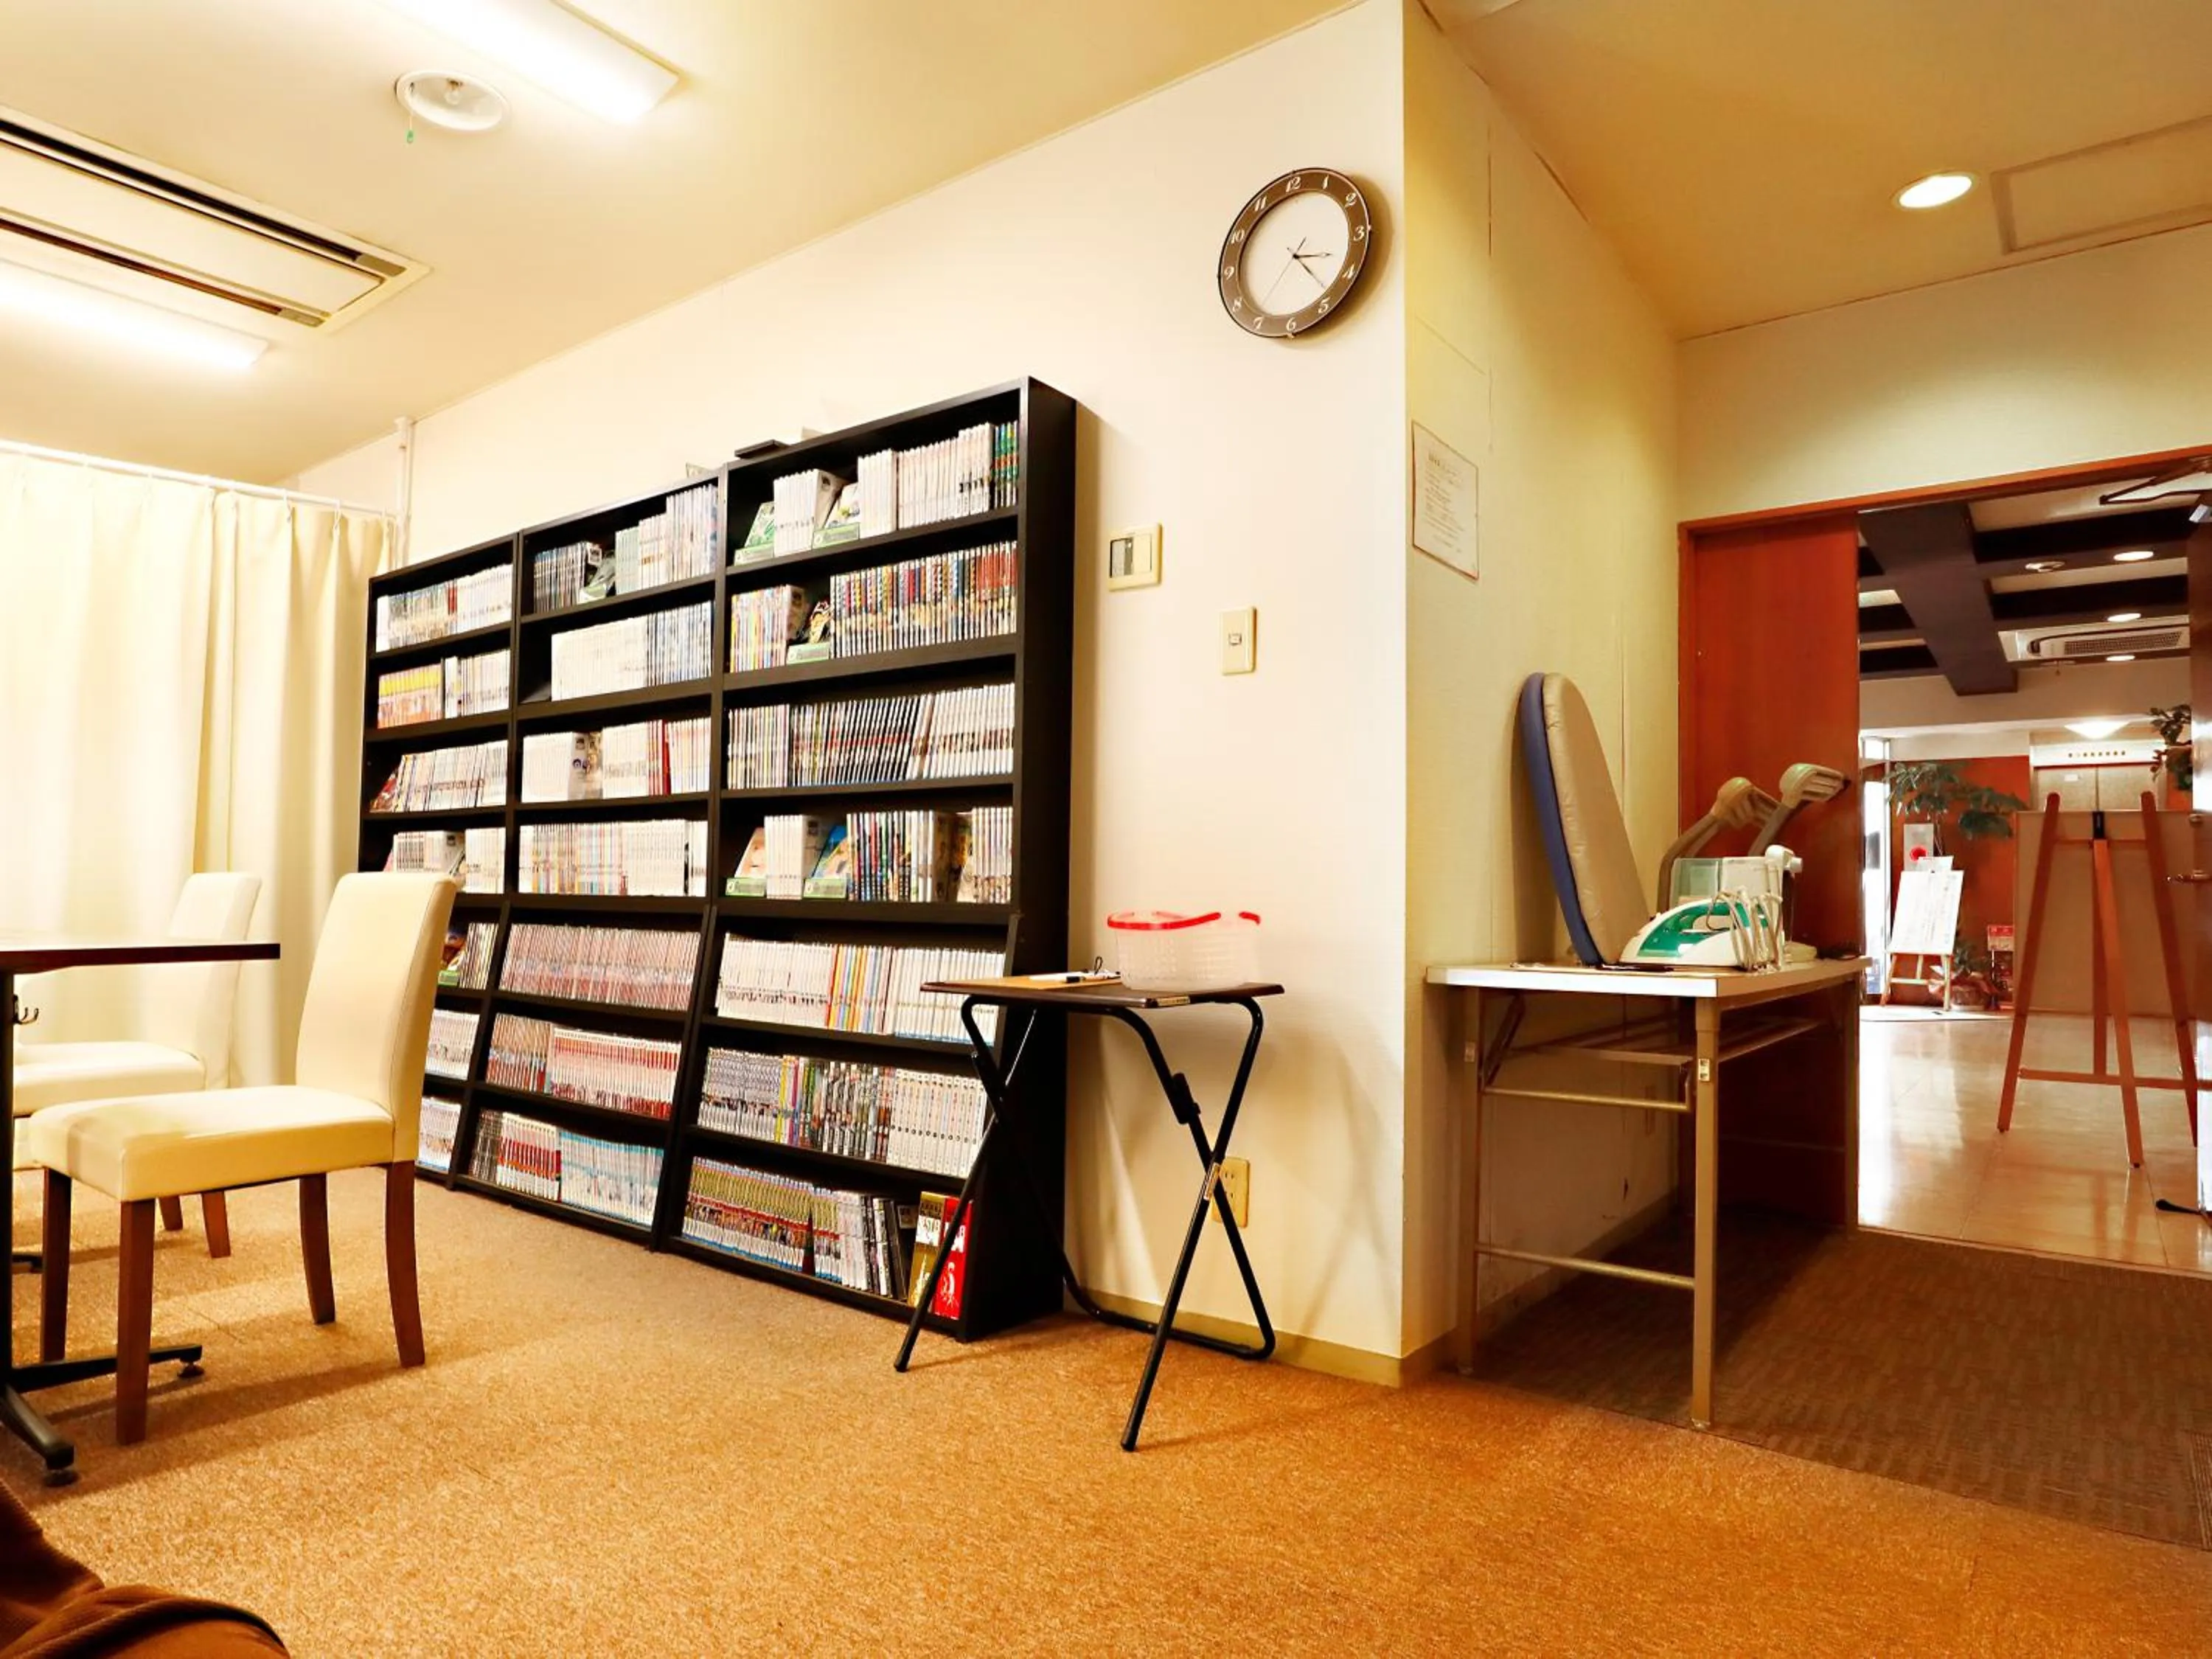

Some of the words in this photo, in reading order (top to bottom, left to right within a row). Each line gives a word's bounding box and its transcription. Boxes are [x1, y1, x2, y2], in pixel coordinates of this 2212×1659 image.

[1285, 176, 1301, 192] 12
[1253, 197, 1267, 212] 11
[1345, 192, 1357, 207] 2
[1230, 229, 1245, 245] 10
[1353, 226, 1366, 240] 3
[1223, 265, 1235, 280] 9
[1343, 264, 1355, 279] 4
[1318, 298, 1330, 314] 5
[1253, 316, 1264, 330] 7
[1286, 317, 1298, 330] 6
